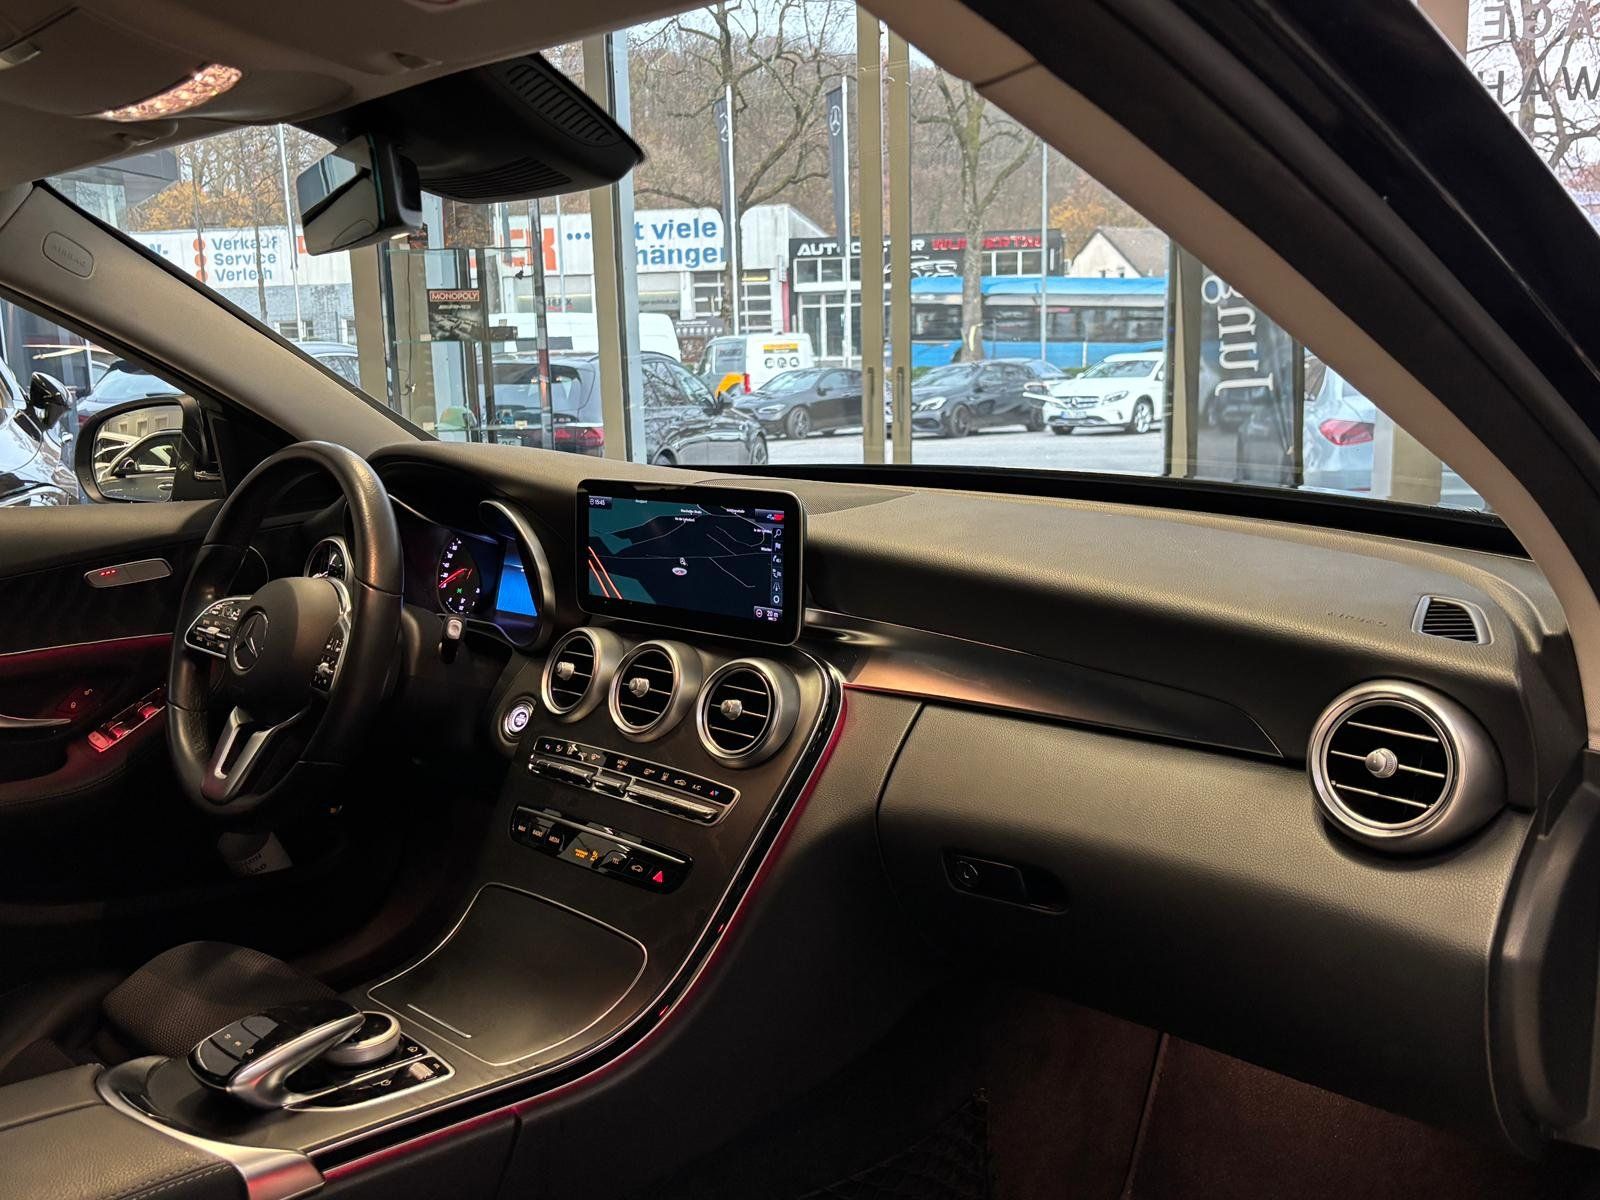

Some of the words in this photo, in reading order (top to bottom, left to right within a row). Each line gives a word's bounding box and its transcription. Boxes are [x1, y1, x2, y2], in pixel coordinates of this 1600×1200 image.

[651, 218, 717, 240] viele
[214, 252, 277, 265] Service
[432, 292, 477, 300] MONOPOLY
